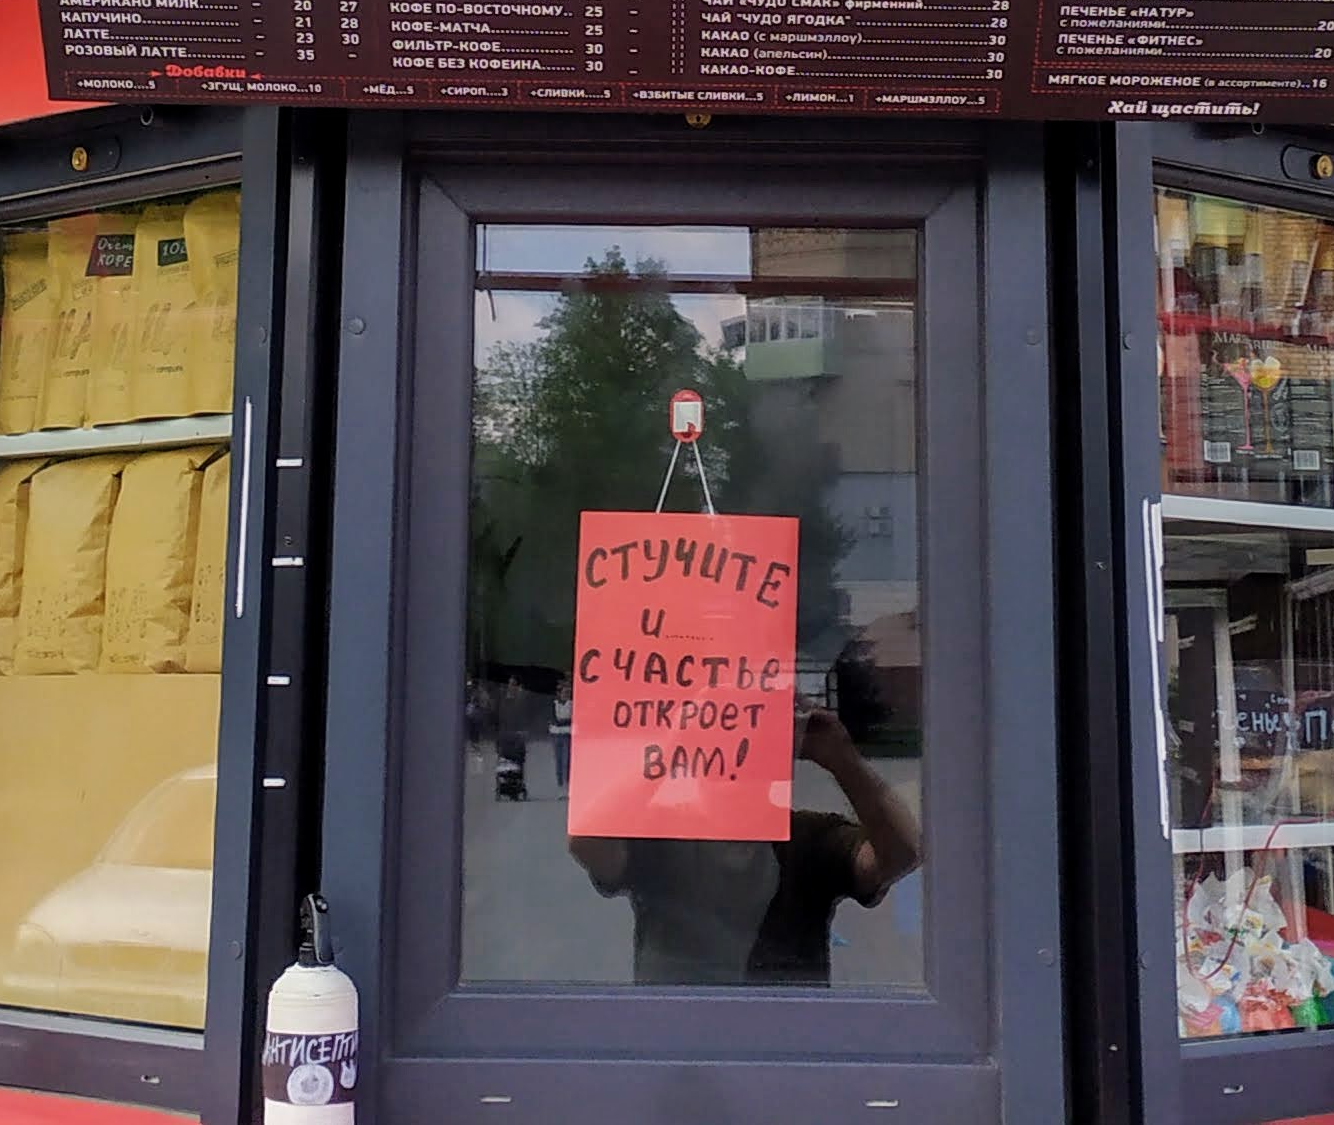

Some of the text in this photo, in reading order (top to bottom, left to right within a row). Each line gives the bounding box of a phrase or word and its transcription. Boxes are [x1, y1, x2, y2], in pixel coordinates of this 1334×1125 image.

[293, 0, 313, 11] 20
[339, 1, 358, 13] 27
[389, 2, 603, 17] КОФЕ ПО-ВОСТОЧНОМУ 25
[991, 0, 1009, 11] 28
[1061, 5, 1127, 17] ПЕЧЕНЬЕ
[61, 11, 359, 29] КАПУЧИНО 21 28
[701, 11, 732, 23] ЧАЙ
[990, 17, 1007, 29] 28
[1059, 19, 1068, 27] с
[1071, 19, 1166, 29] пожеланиями
[391, 21, 603, 36] КОФЕ-МАТЧА 25
[63, 28, 359, 45] ЛАТТЕ 23 30
[701, 31, 750, 41] КАКАО
[753, 31, 767, 43] (с
[989, 35, 1007, 46] 30
[1059, 33, 1125, 45] ПЕЧЕНЬЕ
[65, 44, 315, 61] РОЗОВЫЙ ЛАТТЕ 35
[391, 39, 603, 55] ФИЛЬТР-КОФЕ 30
[1056, 47, 1332, 59] с пожеланиями 20
[701, 47, 1005, 63] КАКАО (апельсин) 30
[165, 63, 246, 79] Добавки
[393, 57, 603, 72] КОФЕ БЕЗ КОФЕИНА 30
[700, 64, 1003, 79] КАКАО-КОФЕ 30
[1048, 75, 1107, 85] МЯГКОЕ
[1109, 75, 1201, 87] МОРОЖЕНОЕ
[1312, 79, 1327, 89] 16
[1107, 101, 1261, 117] Хай щастить!
[585, 537, 791, 609] СТУЧИТЕ
[643, 737, 749, 781] ВАМ!
